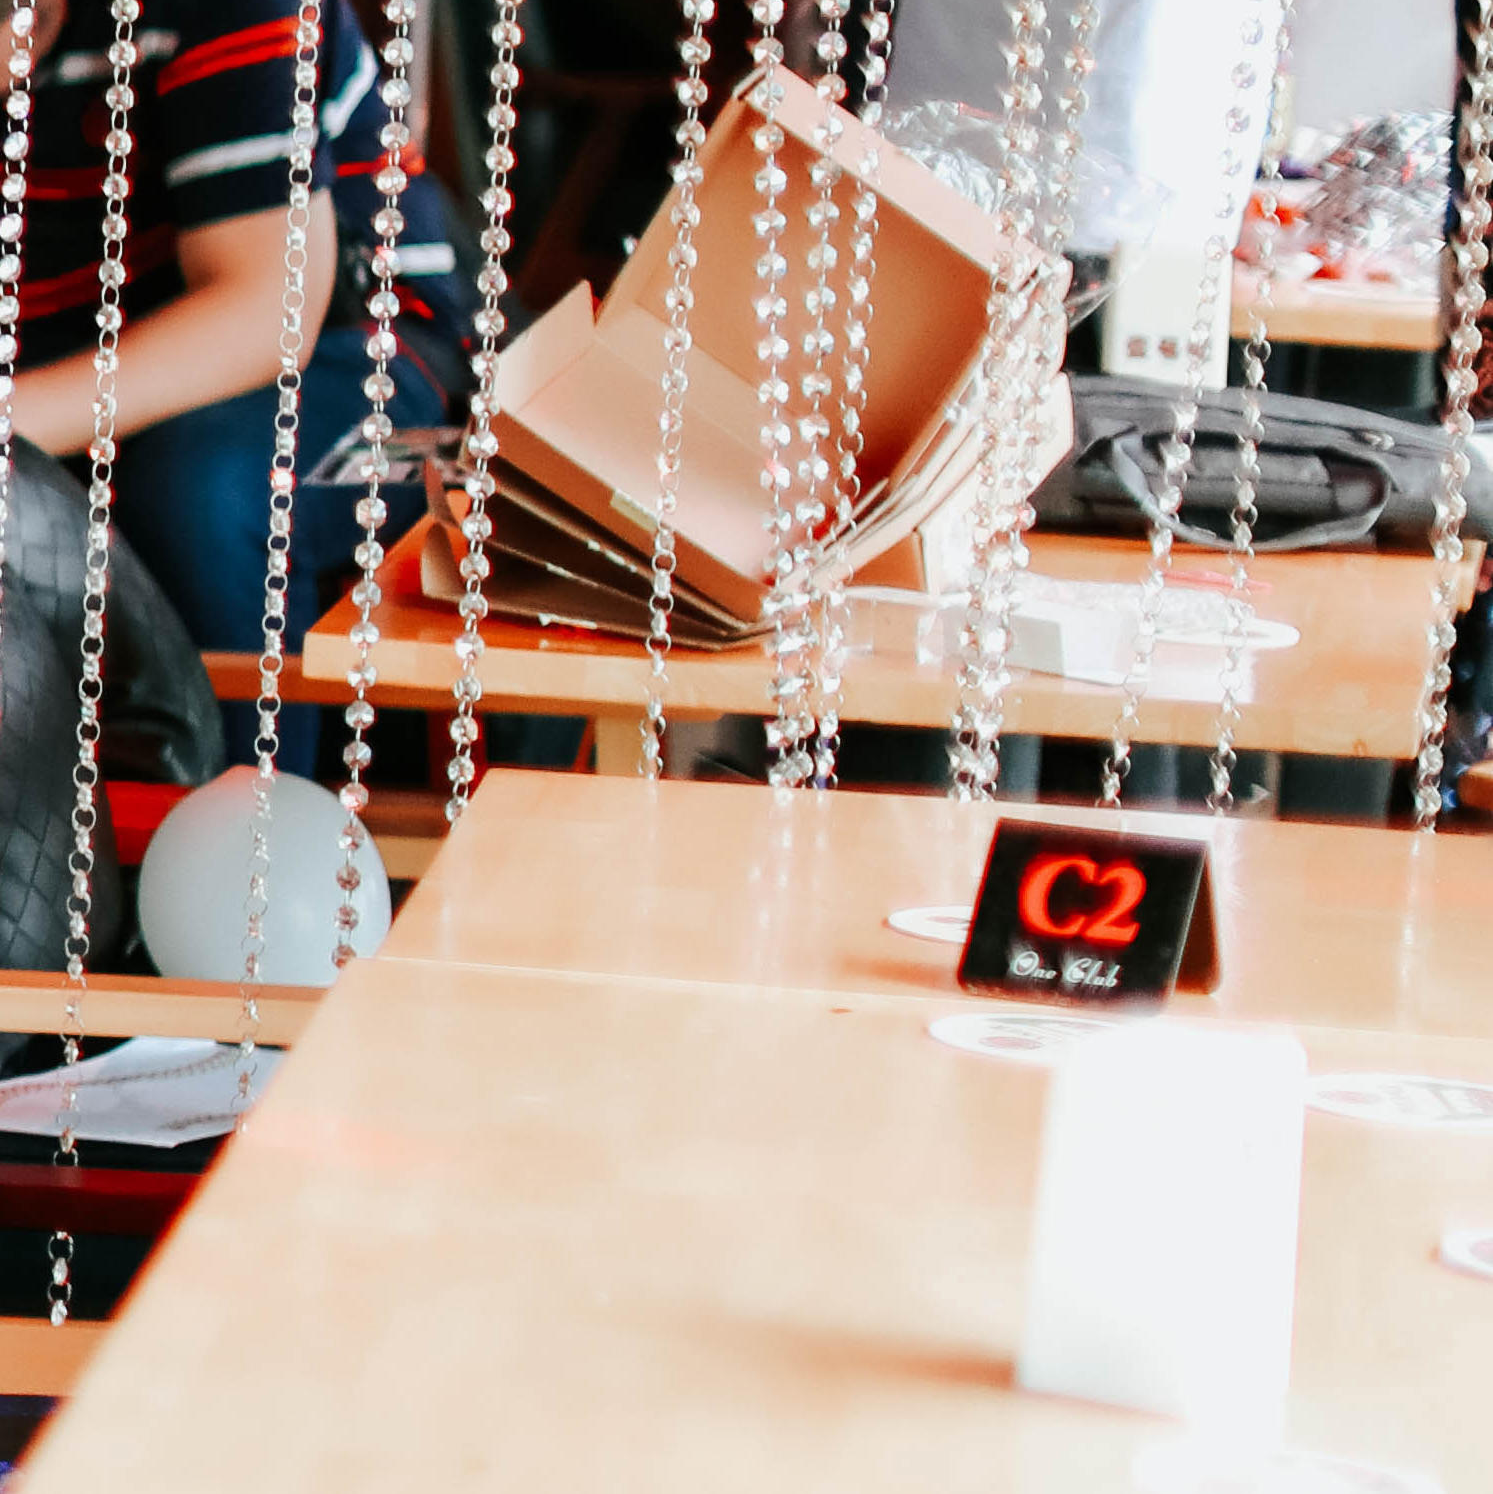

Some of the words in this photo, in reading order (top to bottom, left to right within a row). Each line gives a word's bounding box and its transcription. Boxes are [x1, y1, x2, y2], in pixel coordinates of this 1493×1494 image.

[1019, 854, 1148, 947] C2
[1010, 951, 1057, 981] One
[1066, 958, 1121, 989] Club
